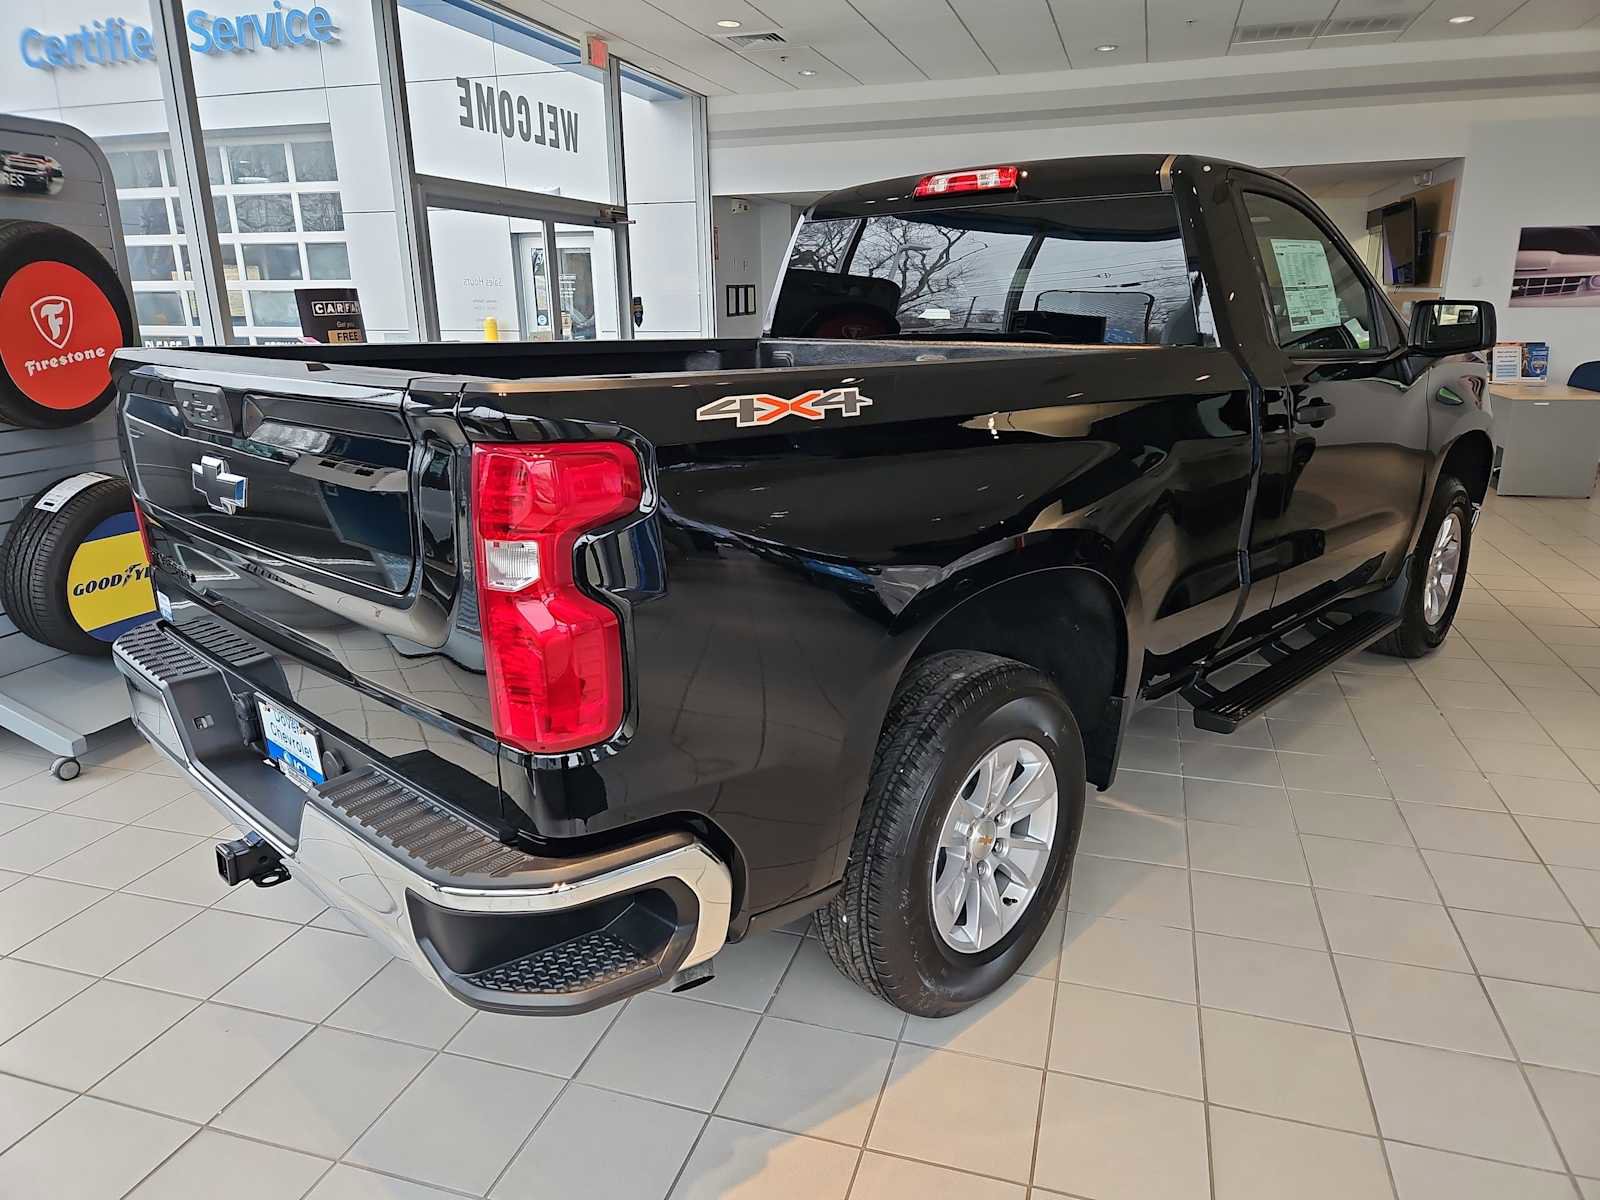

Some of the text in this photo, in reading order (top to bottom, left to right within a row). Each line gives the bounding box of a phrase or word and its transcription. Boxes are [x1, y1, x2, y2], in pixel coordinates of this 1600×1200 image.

[20, 1, 334, 69] Certifie Service
[337, 331, 359, 342] FREE
[25, 347, 106, 377] Firestone
[73, 564, 152, 596] GOODYE
[270, 721, 314, 761] Chevrolet
